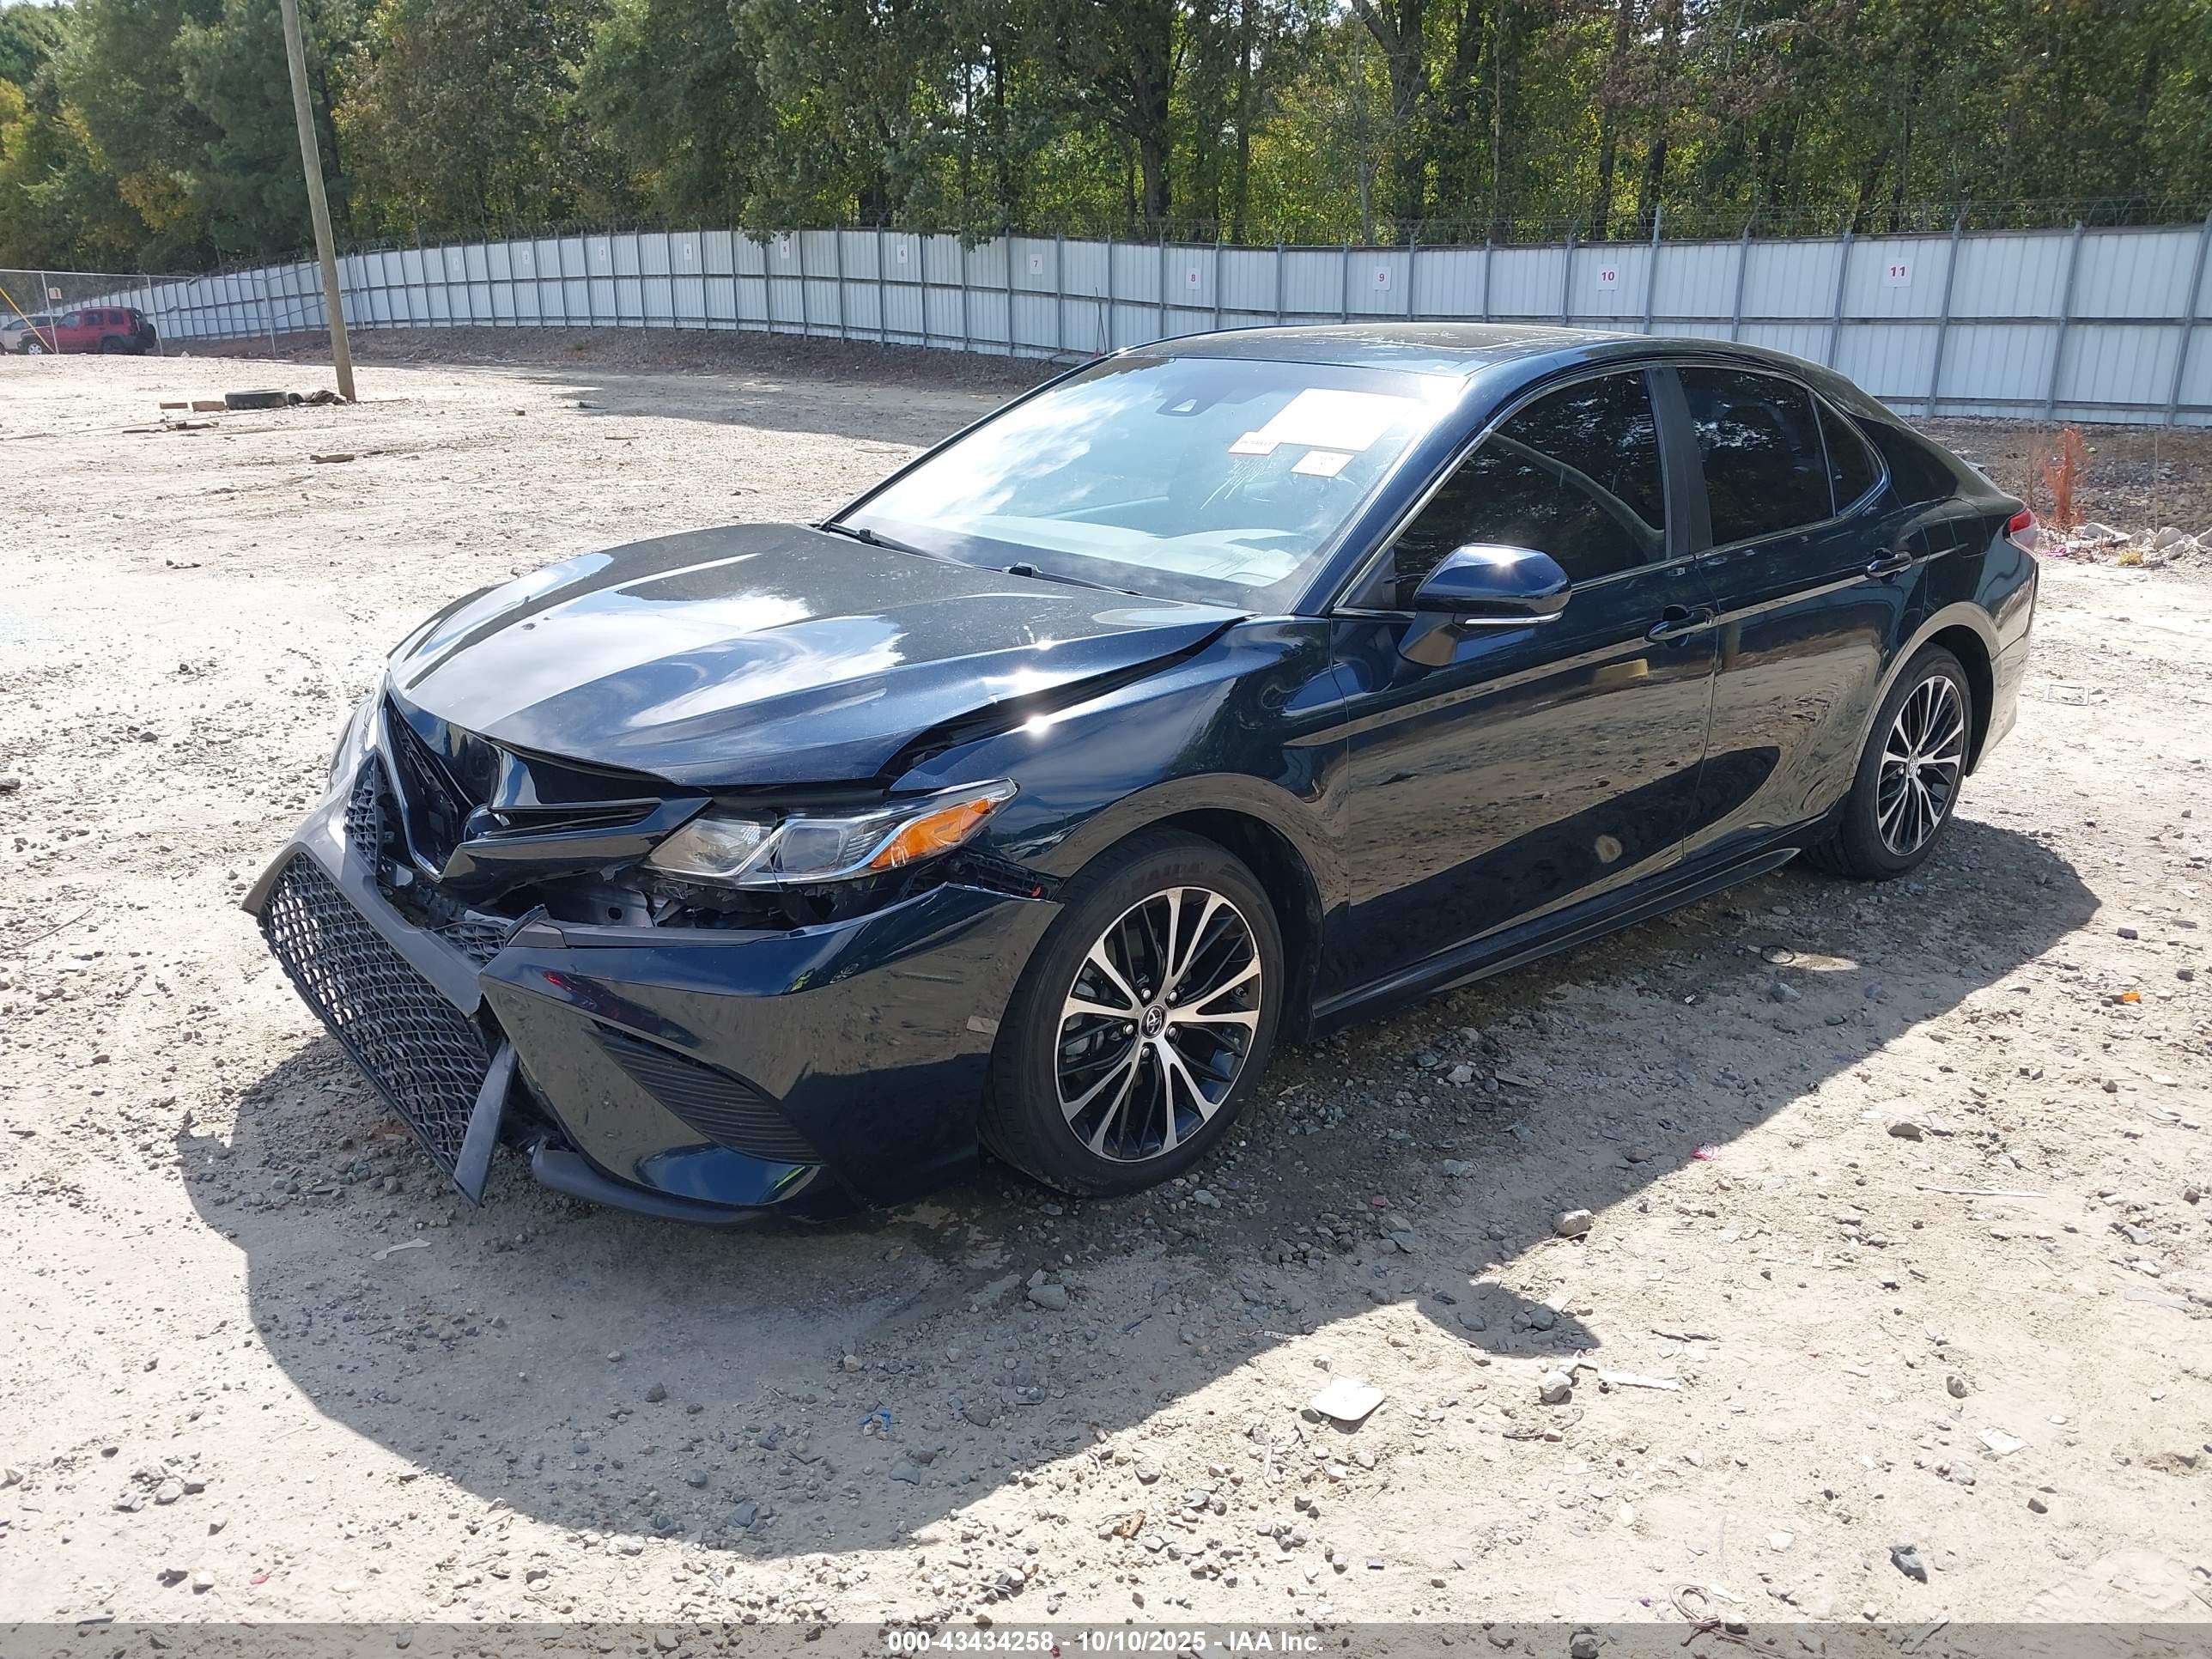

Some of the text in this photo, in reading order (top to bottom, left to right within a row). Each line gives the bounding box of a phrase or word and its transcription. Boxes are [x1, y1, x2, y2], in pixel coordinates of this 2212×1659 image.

[1891, 266, 1905, 276] 11
[1191, 274, 1196, 283] 8
[1379, 273, 1385, 282] 9
[1601, 271, 1614, 281] 10
